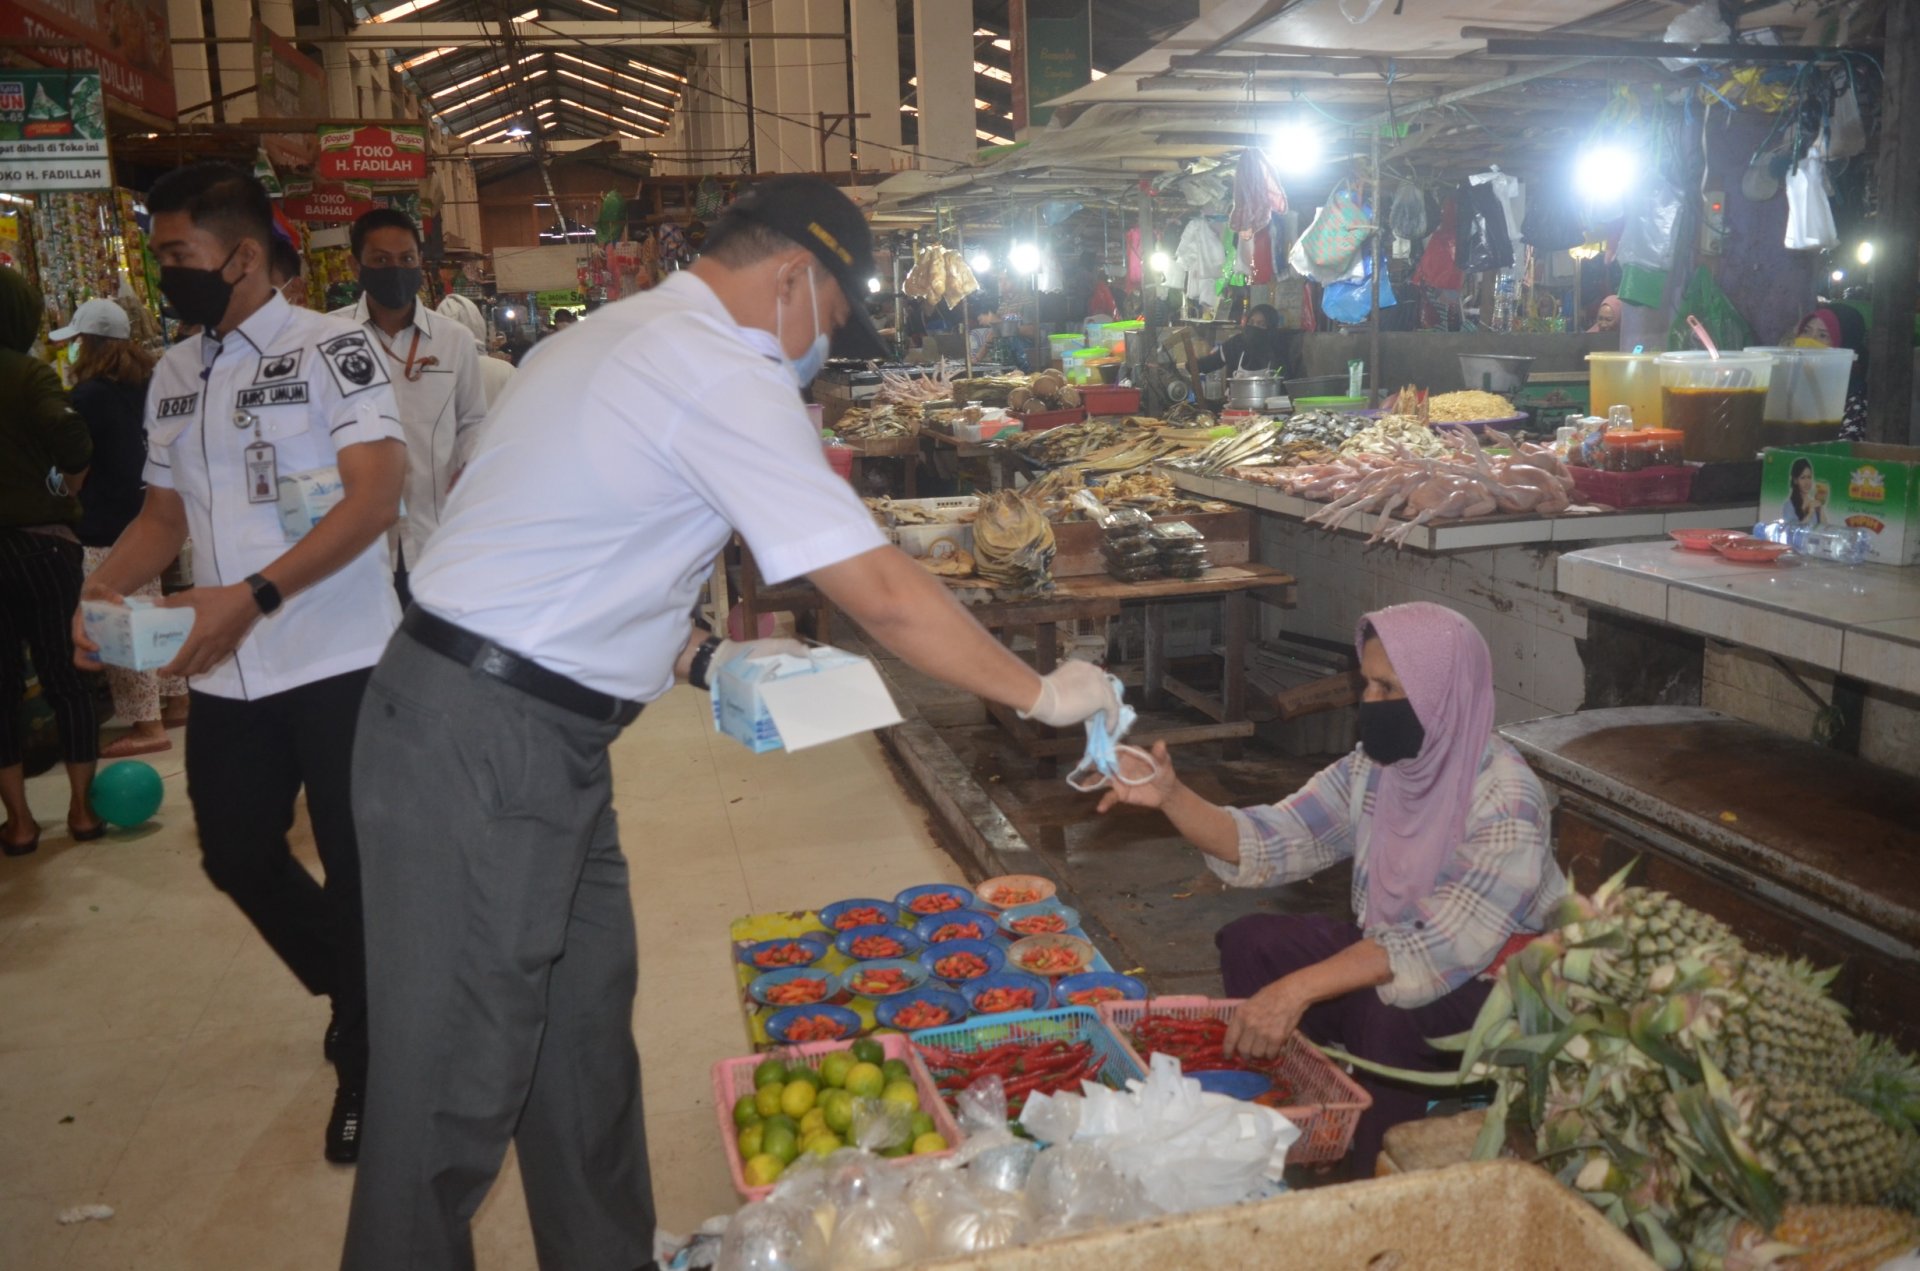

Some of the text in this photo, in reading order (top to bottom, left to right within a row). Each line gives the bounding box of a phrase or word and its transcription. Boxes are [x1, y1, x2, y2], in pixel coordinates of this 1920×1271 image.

[323, 133, 423, 145] Royco Royco
[17, 143, 44, 153] dibeli
[47, 143, 57, 153] di
[58, 143, 84, 153] Toko
[86, 142, 99, 152] ini
[354, 145, 393, 157] TOKO
[335, 160, 412, 171] H. FADILAH
[26, 170, 38, 180] H.
[42, 169, 101, 179] FADILLAH
[312, 194, 346, 204] TOKO
[305, 205, 353, 216] BAIHAKI
